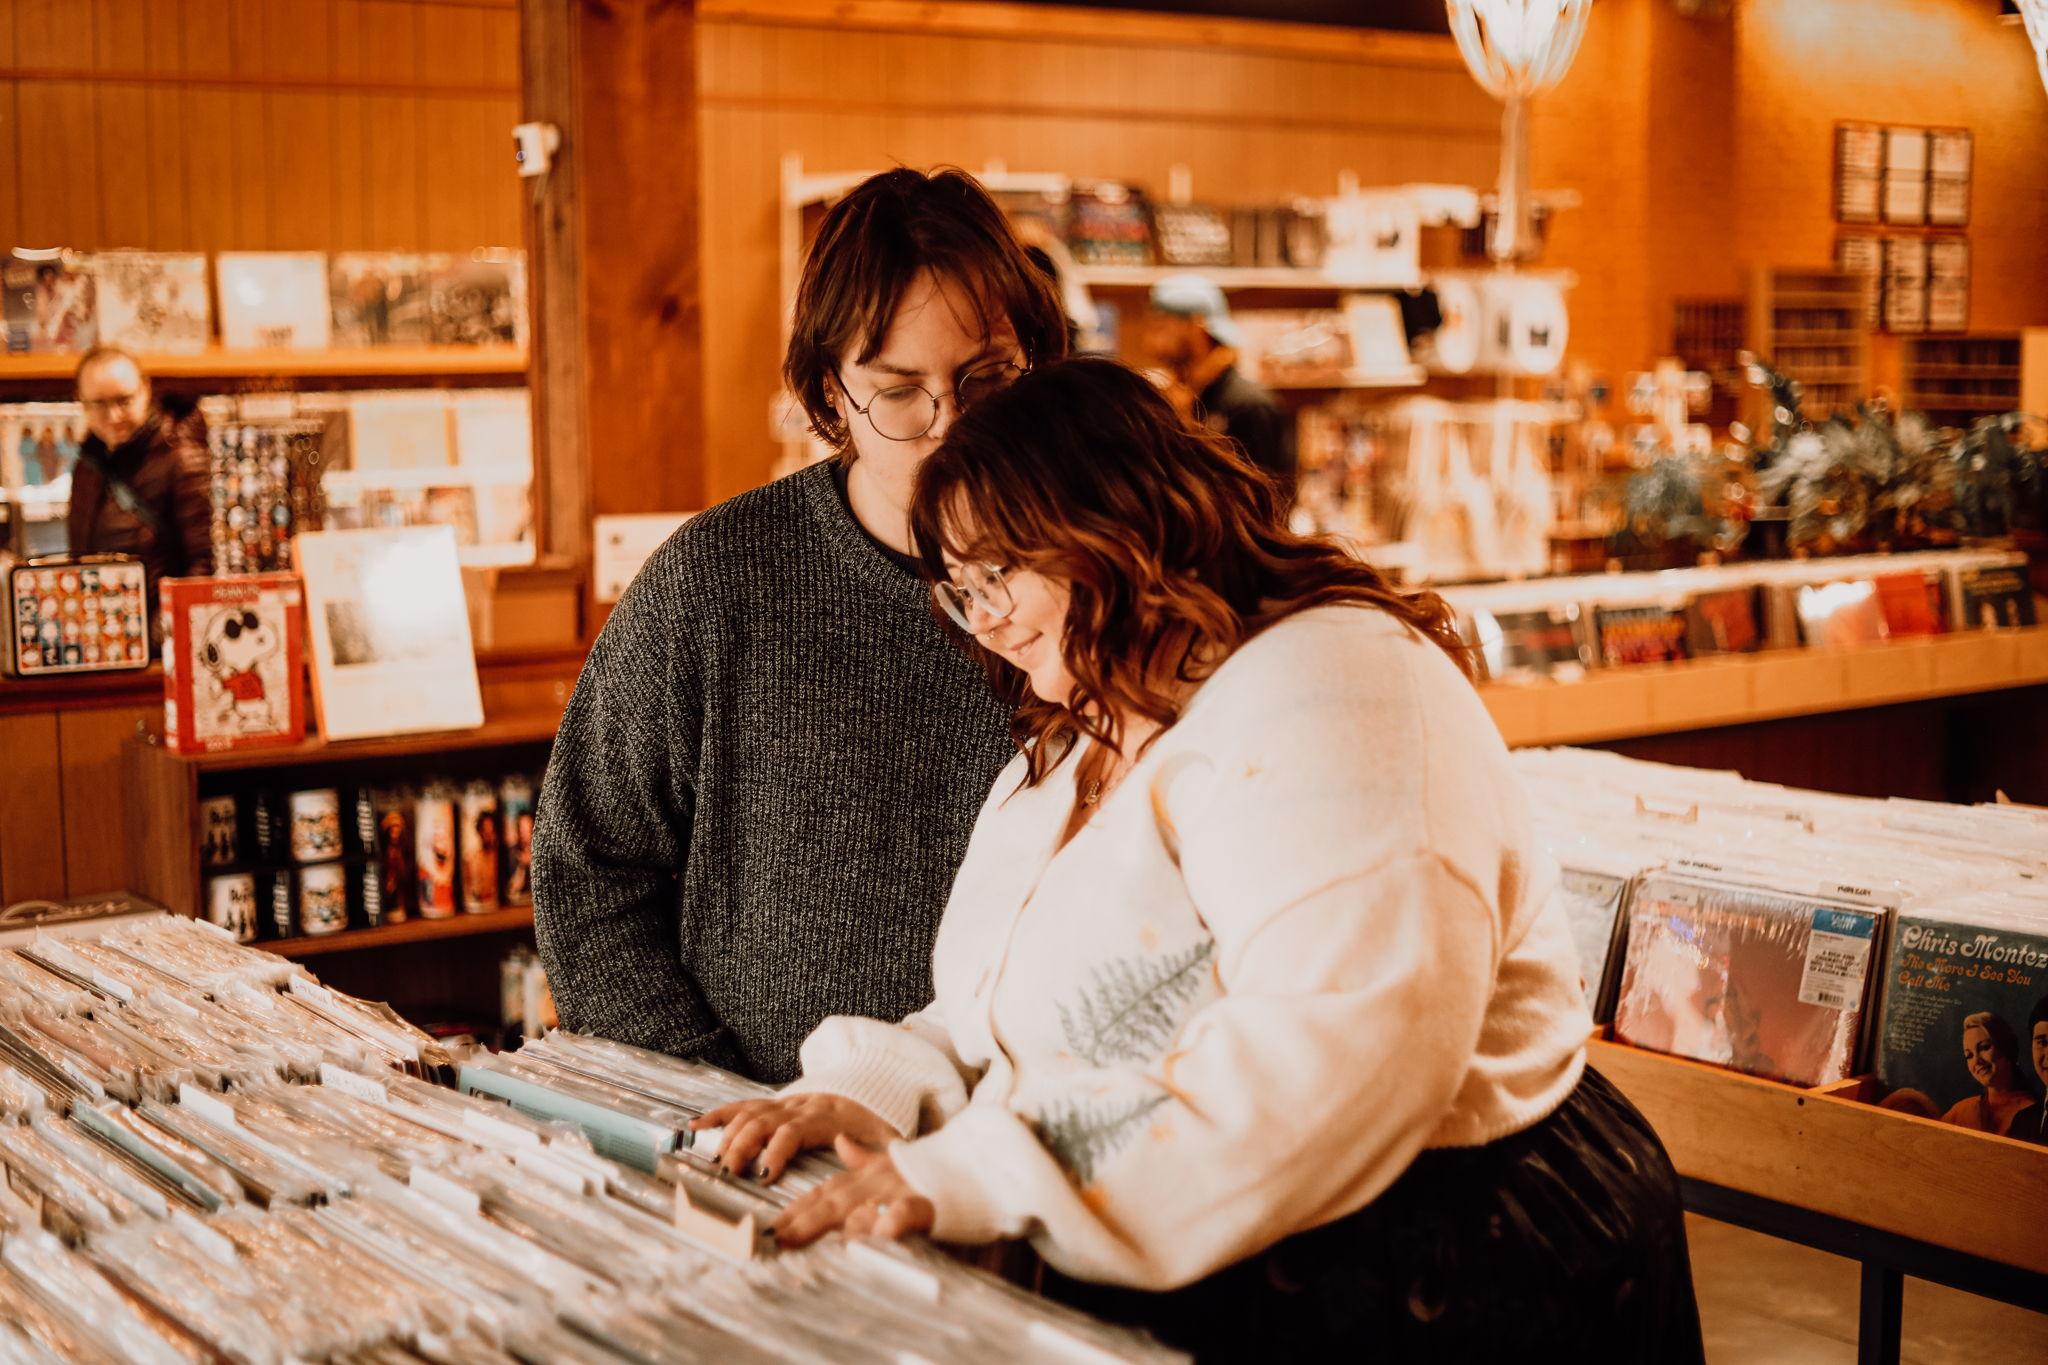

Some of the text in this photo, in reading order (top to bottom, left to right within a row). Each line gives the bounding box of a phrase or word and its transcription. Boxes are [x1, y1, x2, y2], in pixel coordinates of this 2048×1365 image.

[1902, 925, 2048, 969] Chris Montez
[1898, 970, 1952, 992] Call Me
[1900, 953, 1925, 969] The
[1926, 957, 1964, 976] More
[1980, 965, 2004, 982] See
[2006, 968, 2032, 986] You
